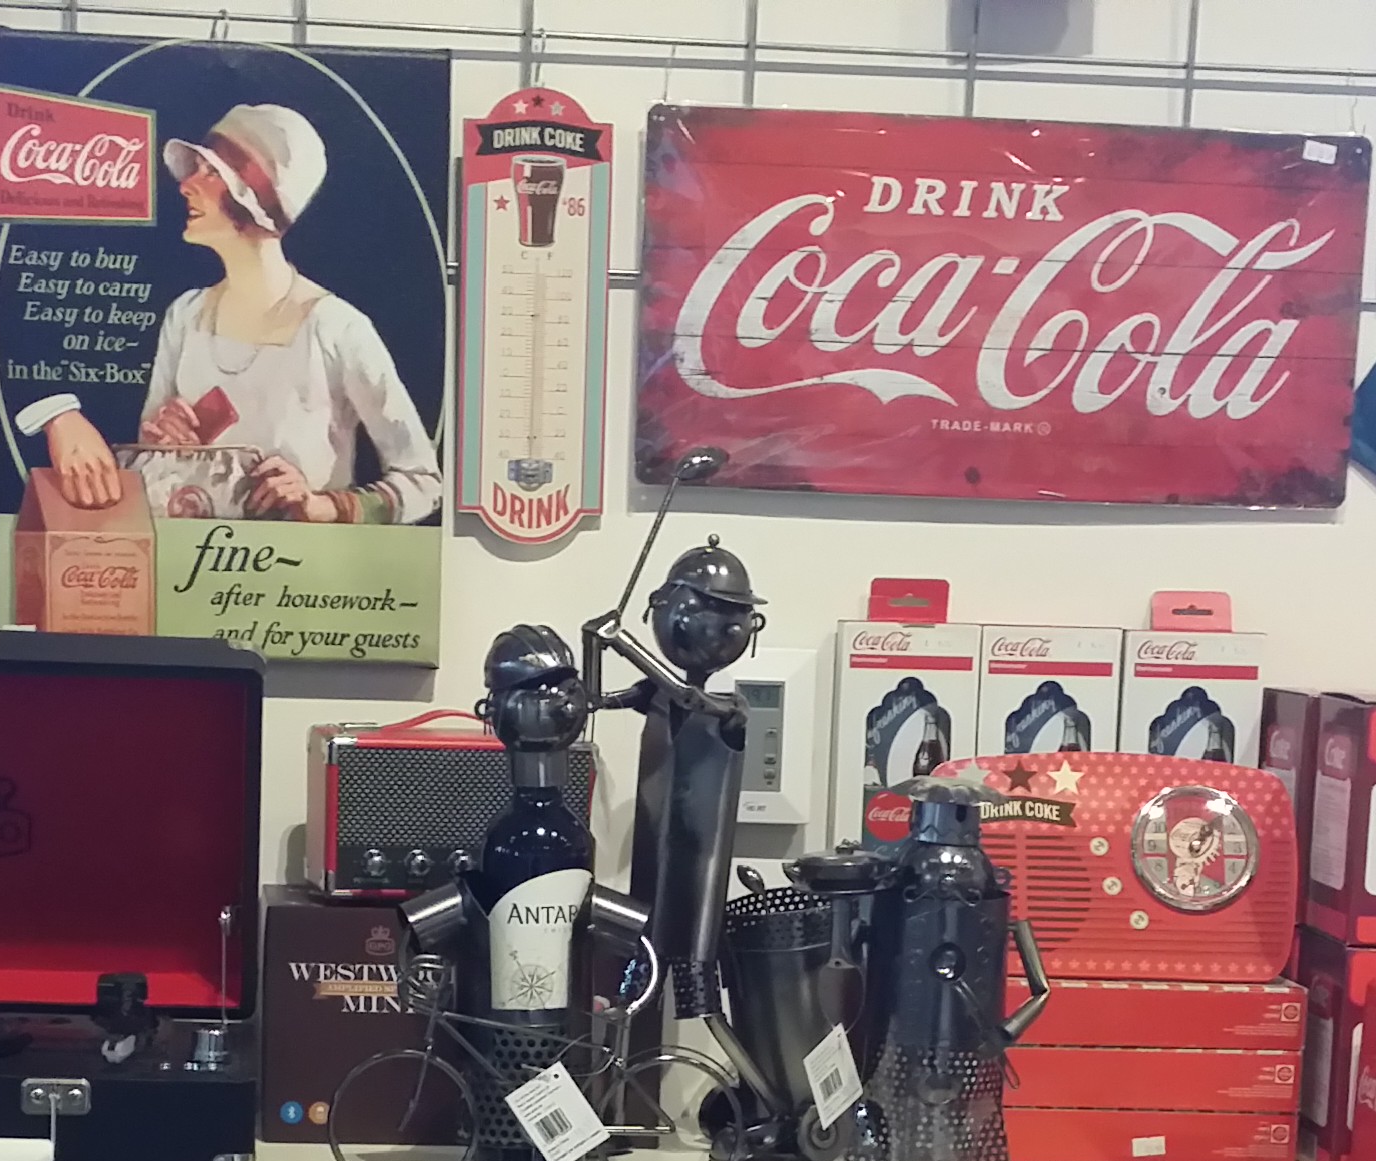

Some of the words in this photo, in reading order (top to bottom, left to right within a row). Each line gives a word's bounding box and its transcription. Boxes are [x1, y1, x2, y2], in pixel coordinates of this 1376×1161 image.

[7, 103, 55, 122] Drink
[492, 126, 542, 149] DRINK
[544, 127, 585, 152] COKE
[0, 124, 145, 189] Coca-Cola
[518, 179, 558, 196] Coca-Cola
[862, 174, 1071, 223] DRINK
[9, 245, 61, 269] Easy
[71, 249, 92, 268] to
[95, 248, 138, 275] buy
[18, 273, 70, 299] Easy
[76, 278, 96, 295] to
[99, 281, 152, 303] carry
[24, 302, 78, 328] Easy
[82, 305, 104, 324] to
[107, 304, 156, 331] keep
[673, 193, 1337, 421] Coca-Cola
[62, 335, 89, 351] on
[7, 361, 30, 380] in
[32, 361, 62, 381] the
[493, 481, 570, 529] DRINK
[61, 565, 141, 589] Coca-Cola
[210, 584, 265, 619] after
[212, 622, 256, 643] and
[261, 628, 293, 652] for
[297, 631, 351, 659] your
[354, 630, 421, 658] guests
[852, 630, 913, 652] Coca-Cola
[991, 636, 1052, 658] Coca-Cola
[1137, 640, 1198, 661] Coca-Cola
[981, 801, 1022, 819] DRINK
[1025, 802, 1060, 821] COKE
